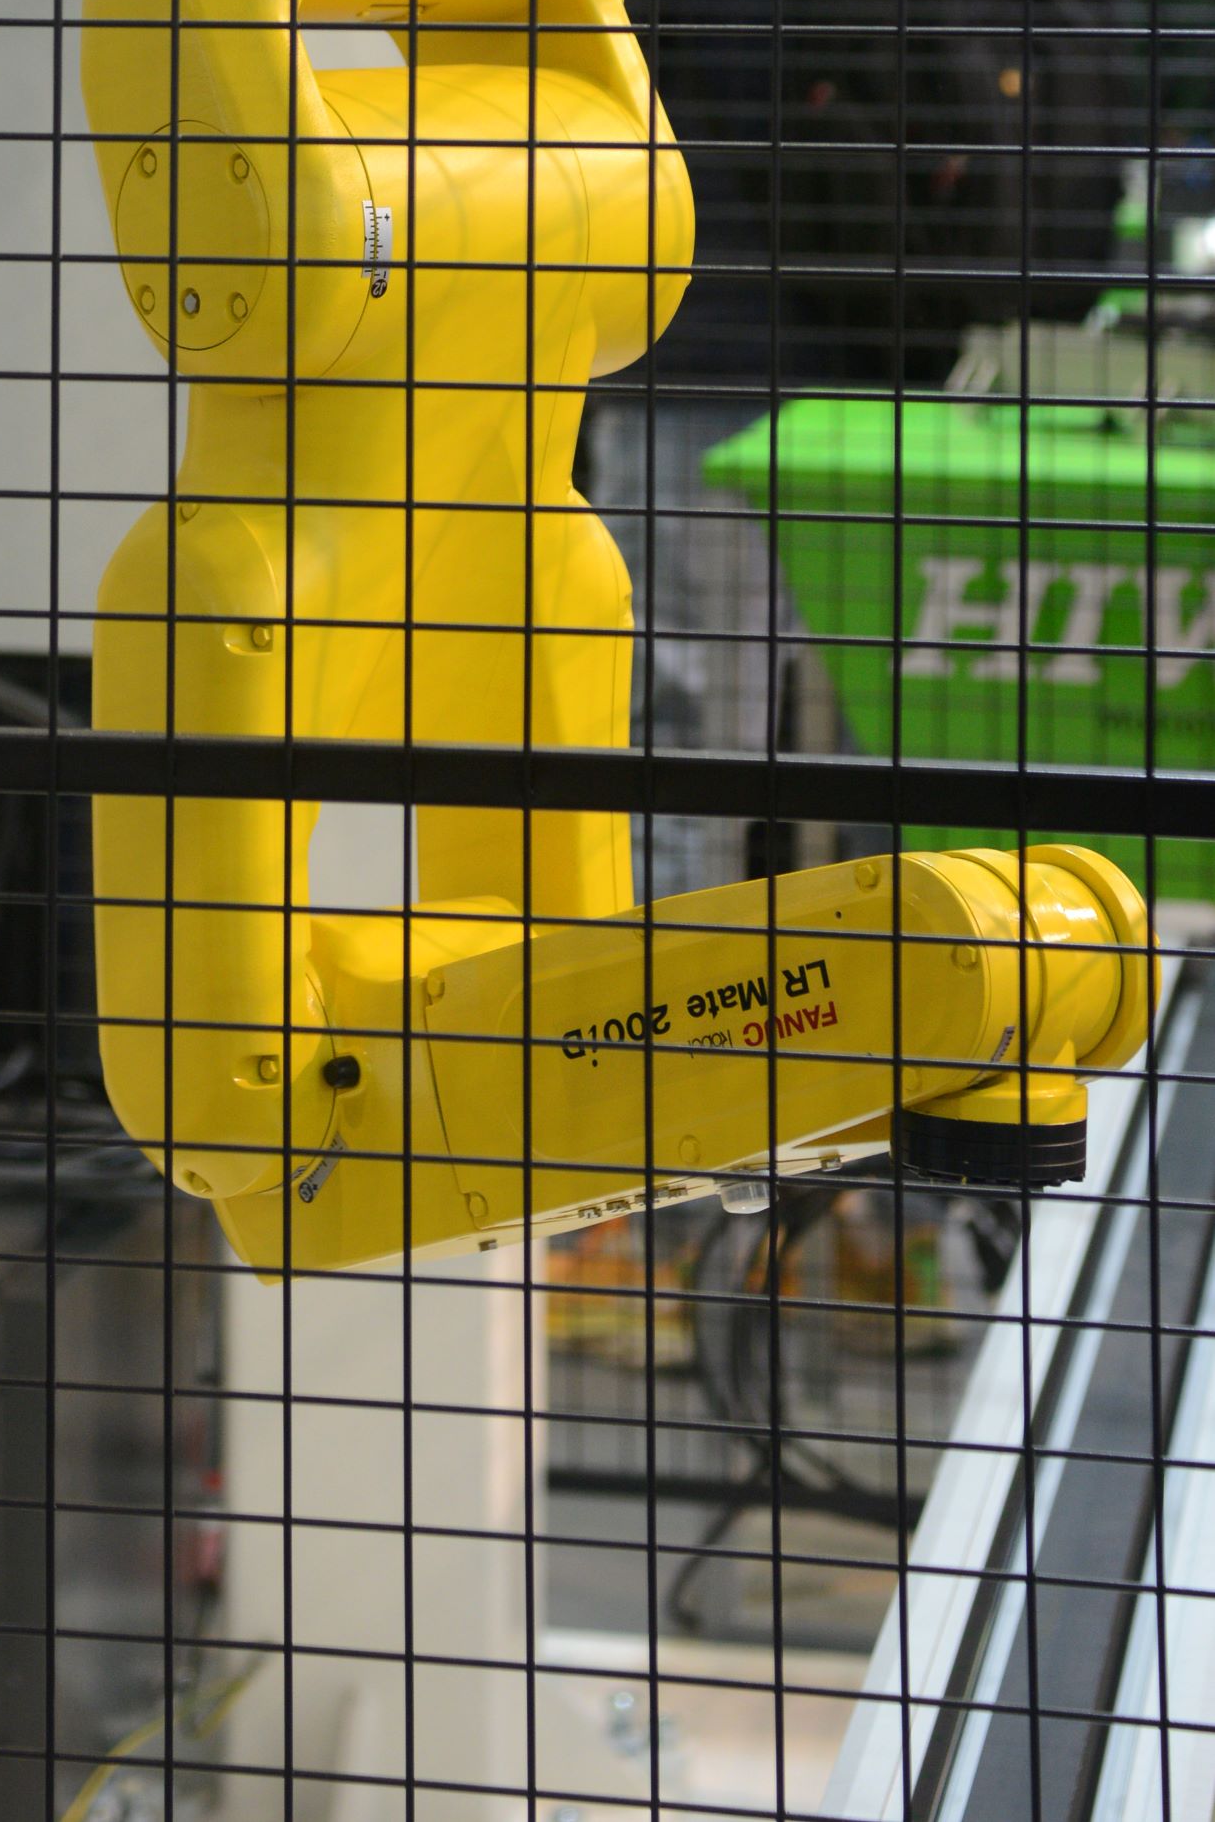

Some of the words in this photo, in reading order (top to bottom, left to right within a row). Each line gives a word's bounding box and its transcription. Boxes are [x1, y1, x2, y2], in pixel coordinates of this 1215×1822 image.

[686, 976, 769, 1020] Mate
[782, 959, 831, 998] LR
[742, 1001, 839, 1047] FANUC
